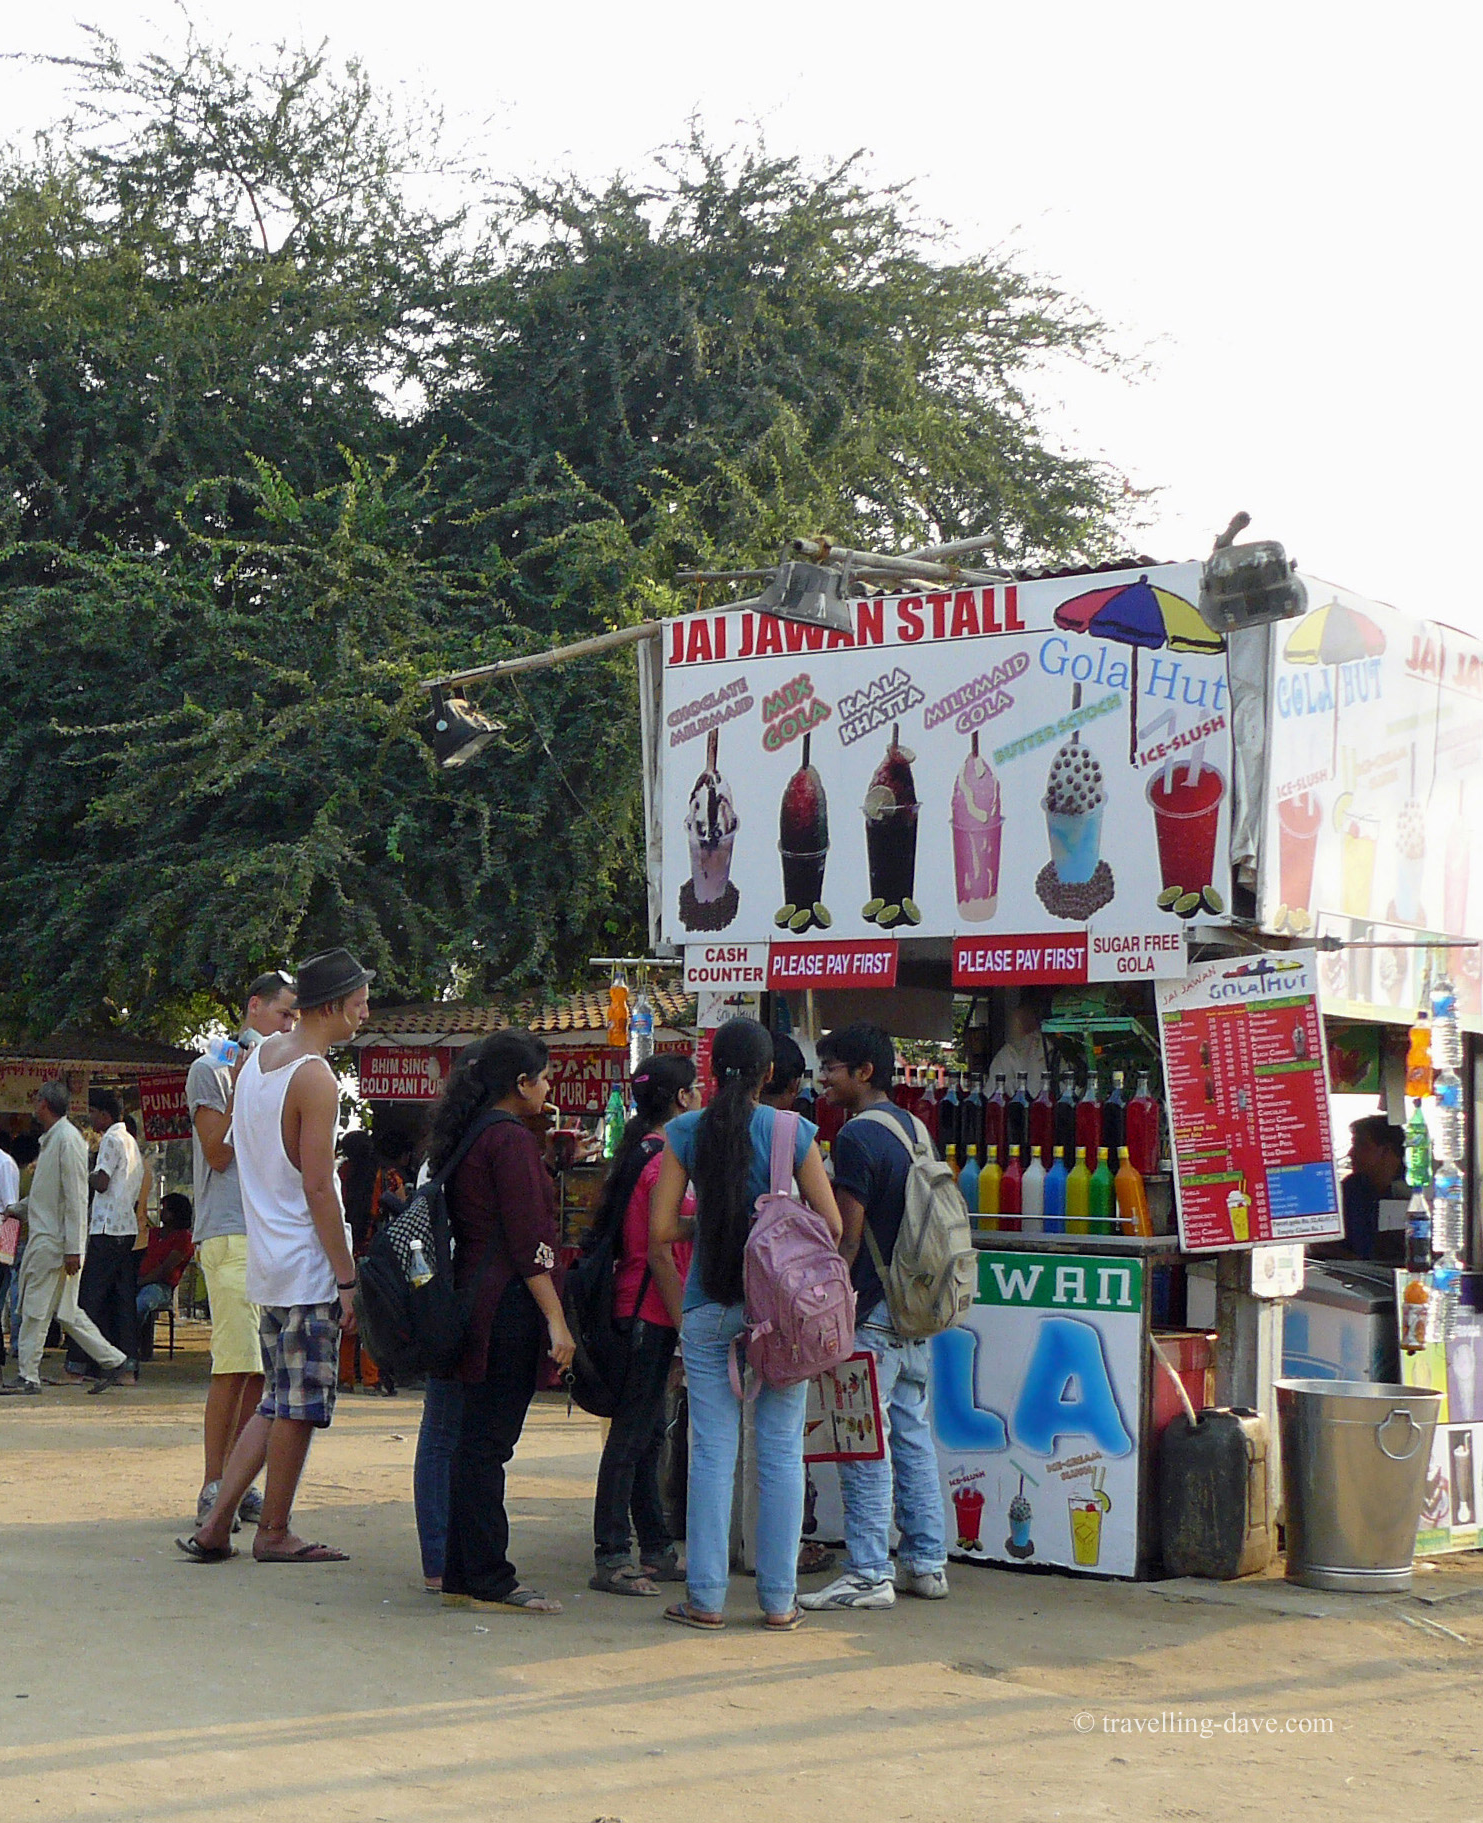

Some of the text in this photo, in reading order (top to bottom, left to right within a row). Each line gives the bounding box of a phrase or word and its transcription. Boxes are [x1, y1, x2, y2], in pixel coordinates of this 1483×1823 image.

[669, 617, 727, 665] JAI
[897, 585, 1026, 642] STALL
[838, 667, 911, 720] KAALA
[923, 652, 1030, 730] MILKMAID
[1039, 637, 1227, 710] Gola Hut
[1277, 658, 1382, 718] GOLA HUT
[1453, 652, 1483, 693] JA
[762, 673, 814, 723] MIX
[838, 685, 925, 746] KHATTA
[955, 690, 1014, 734] GOLA
[670, 696, 754, 747] MILKMAID
[763, 697, 832, 752] GOLA
[1139, 715, 1226, 766] ICE-SLUSH
[705, 948, 748, 963] CASH
[772, 952, 892, 976] PLEASE PAY FIRST
[958, 947, 1086, 972] PLEASE PAY FIRST
[1094, 934, 1180, 953] SUGAR FREE
[1118, 956, 1155, 973] GOLA
[687, 967, 764, 983] COUNTER
[1181, 965, 1217, 995] JAWAN
[1209, 974, 1309, 999] GOLA HUT
[361, 1077, 445, 1095] COLD PANI PUR
[371, 1058, 429, 1074] BHIM SING
[141, 1092, 188, 1111] PUNJA
[560, 1082, 587, 1106] PURI
[973, 1262, 1132, 1307] WAN
[931, 1314, 1132, 1457] LA
